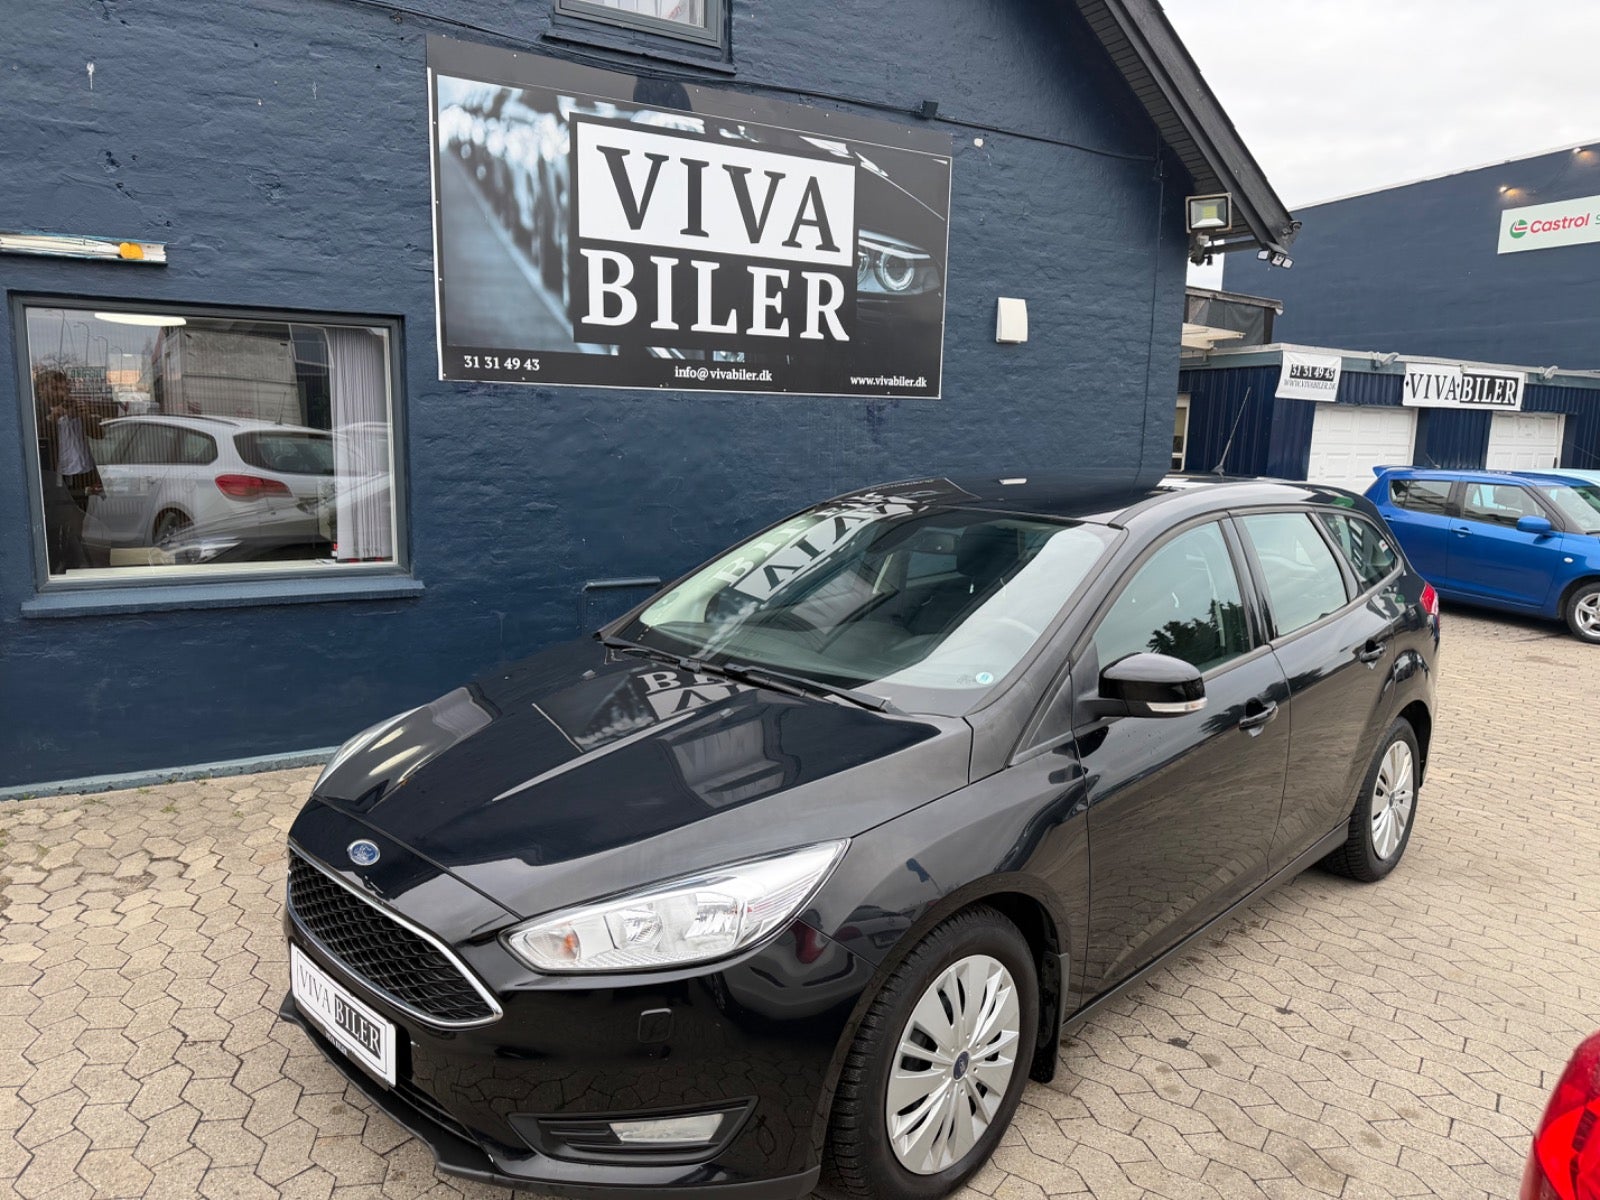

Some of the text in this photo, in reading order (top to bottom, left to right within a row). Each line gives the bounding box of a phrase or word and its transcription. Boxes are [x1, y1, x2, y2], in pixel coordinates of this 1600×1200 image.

[596, 144, 841, 253] VIVA
[1530, 213, 1590, 233] Castrol
[579, 247, 850, 342] BILER
[463, 355, 540, 371] 31 31 49 43
[850, 375, 928, 388] www.vivabiler.dk
[1409, 373, 1517, 404] VIVA BILER
[299, 964, 332, 1014] VIVA
[335, 996, 382, 1059] BILER
